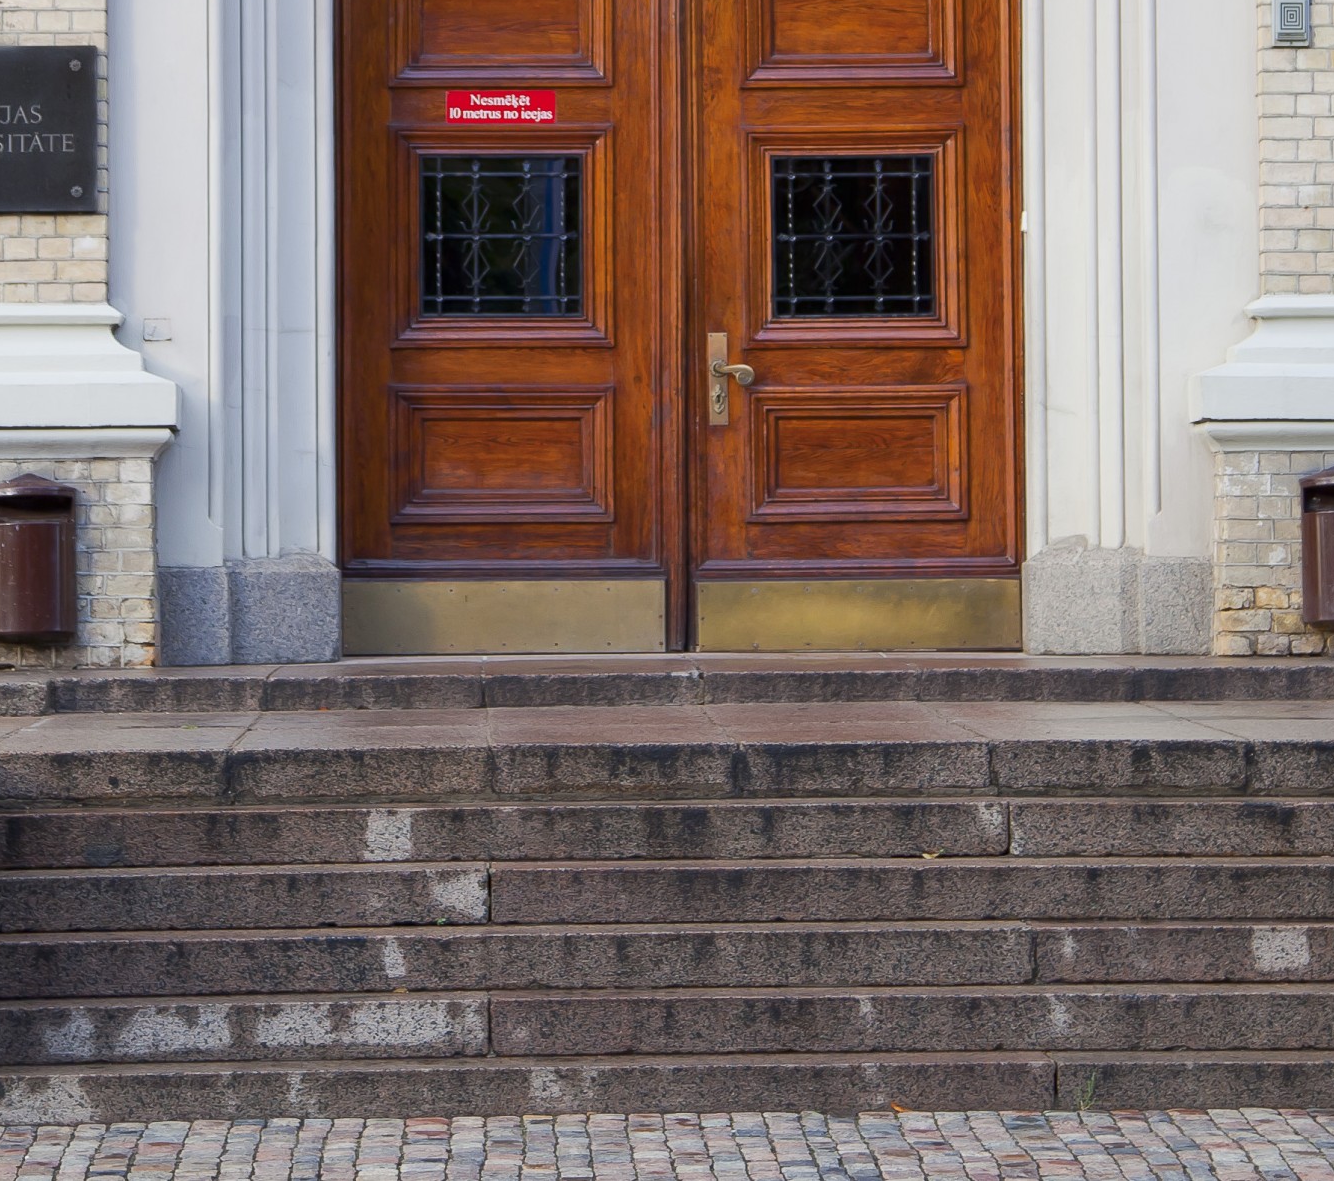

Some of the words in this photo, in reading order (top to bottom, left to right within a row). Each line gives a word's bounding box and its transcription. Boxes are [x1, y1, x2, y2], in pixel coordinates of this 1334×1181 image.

[470, 94, 531, 109] Nesmēķēt
[449, 107, 462, 119] 10
[462, 108, 502, 120] metrus
[503, 110, 519, 120] no
[521, 107, 553, 122] ieejas
